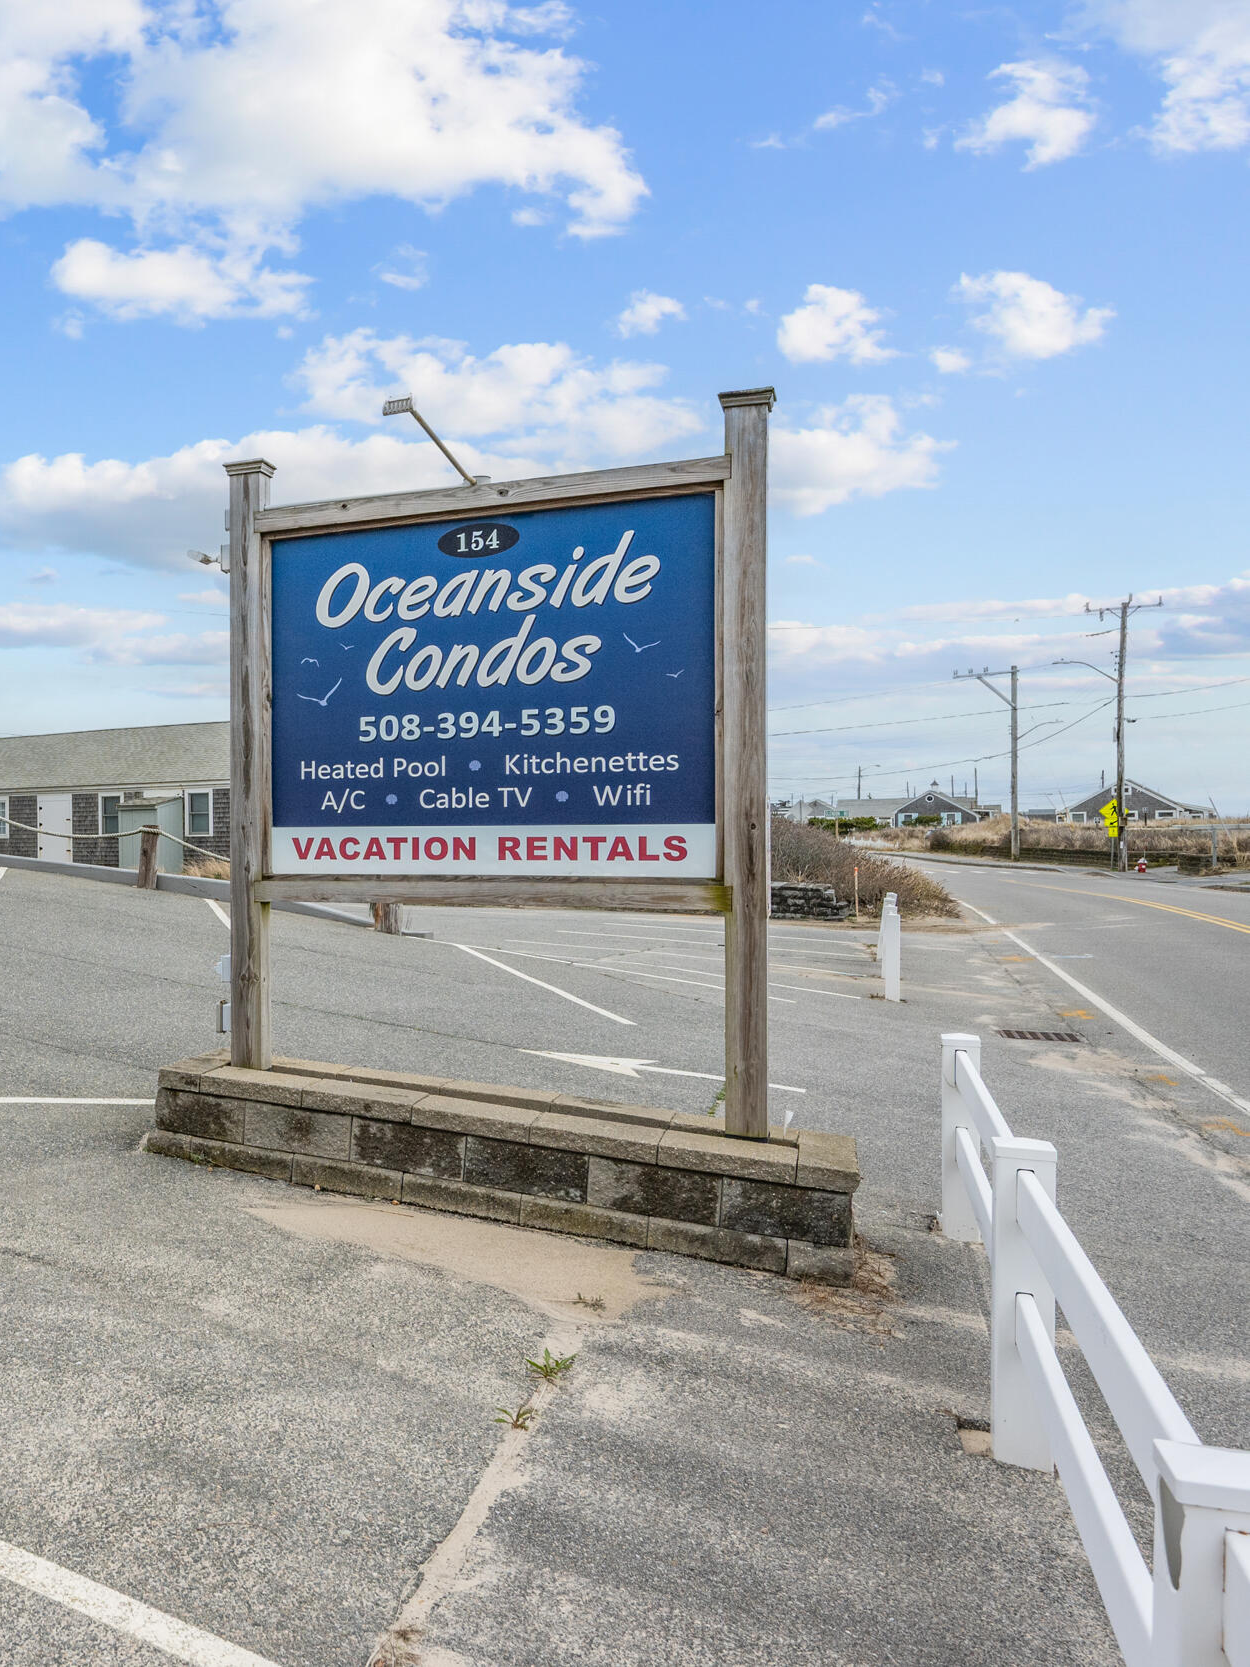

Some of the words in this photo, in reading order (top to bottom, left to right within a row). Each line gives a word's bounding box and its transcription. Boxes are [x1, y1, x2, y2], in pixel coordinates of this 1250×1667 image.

[456, 528, 500, 553] 154
[315, 529, 661, 629] Oceanside
[365, 614, 602, 696] Condos
[358, 705, 617, 743] 508-394-5359
[300, 758, 385, 780] Heated
[393, 755, 447, 778] Pool
[505, 751, 680, 776] Kitchenettes
[321, 788, 366, 813] A/C
[419, 786, 490, 809] Cable
[497, 786, 533, 808] TV
[593, 783, 652, 806] Wifi
[292, 836, 477, 861] VACATION
[497, 835, 688, 861] RENTALS
